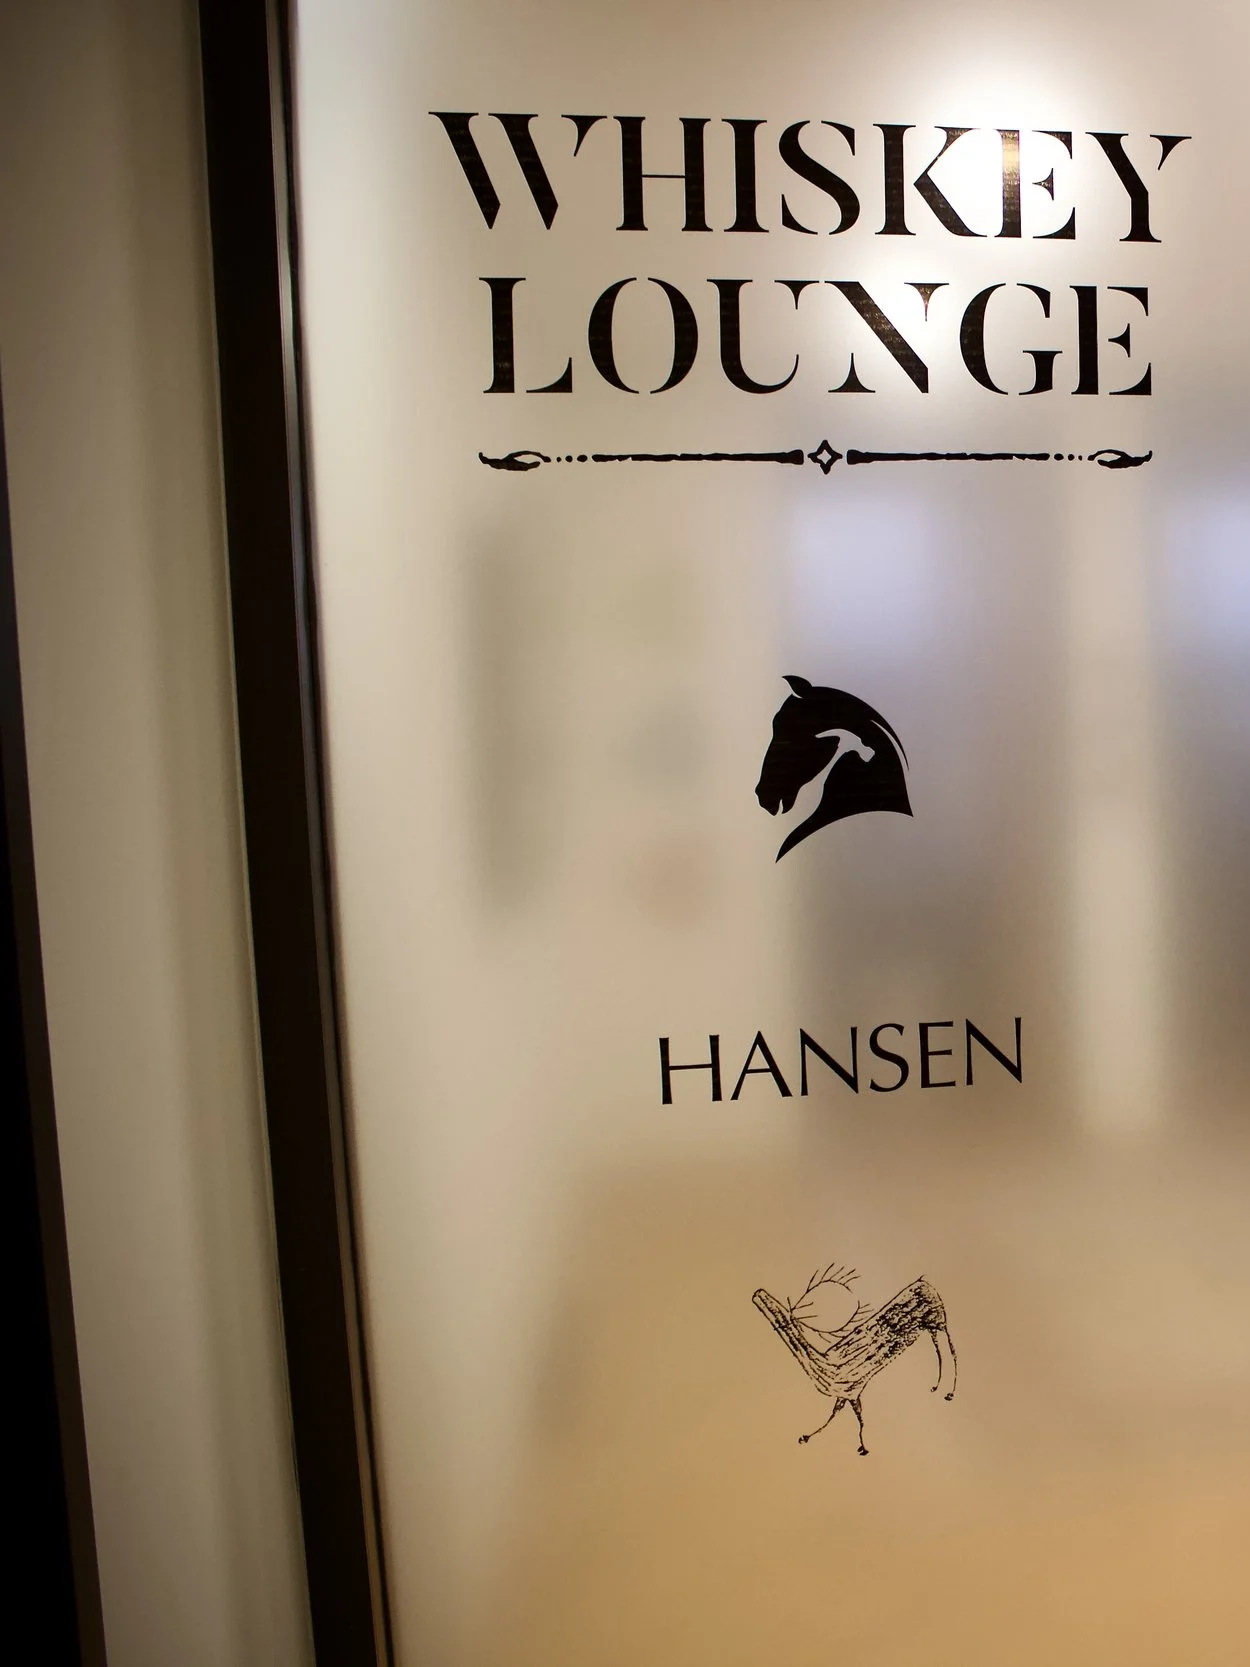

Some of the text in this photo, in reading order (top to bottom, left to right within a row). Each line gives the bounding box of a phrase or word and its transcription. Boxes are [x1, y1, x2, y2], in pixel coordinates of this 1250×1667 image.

[428, 111, 1192, 243] WHISKEY
[479, 277, 1152, 396] LOUNGE
[659, 1016, 1023, 1105] HANSEN
